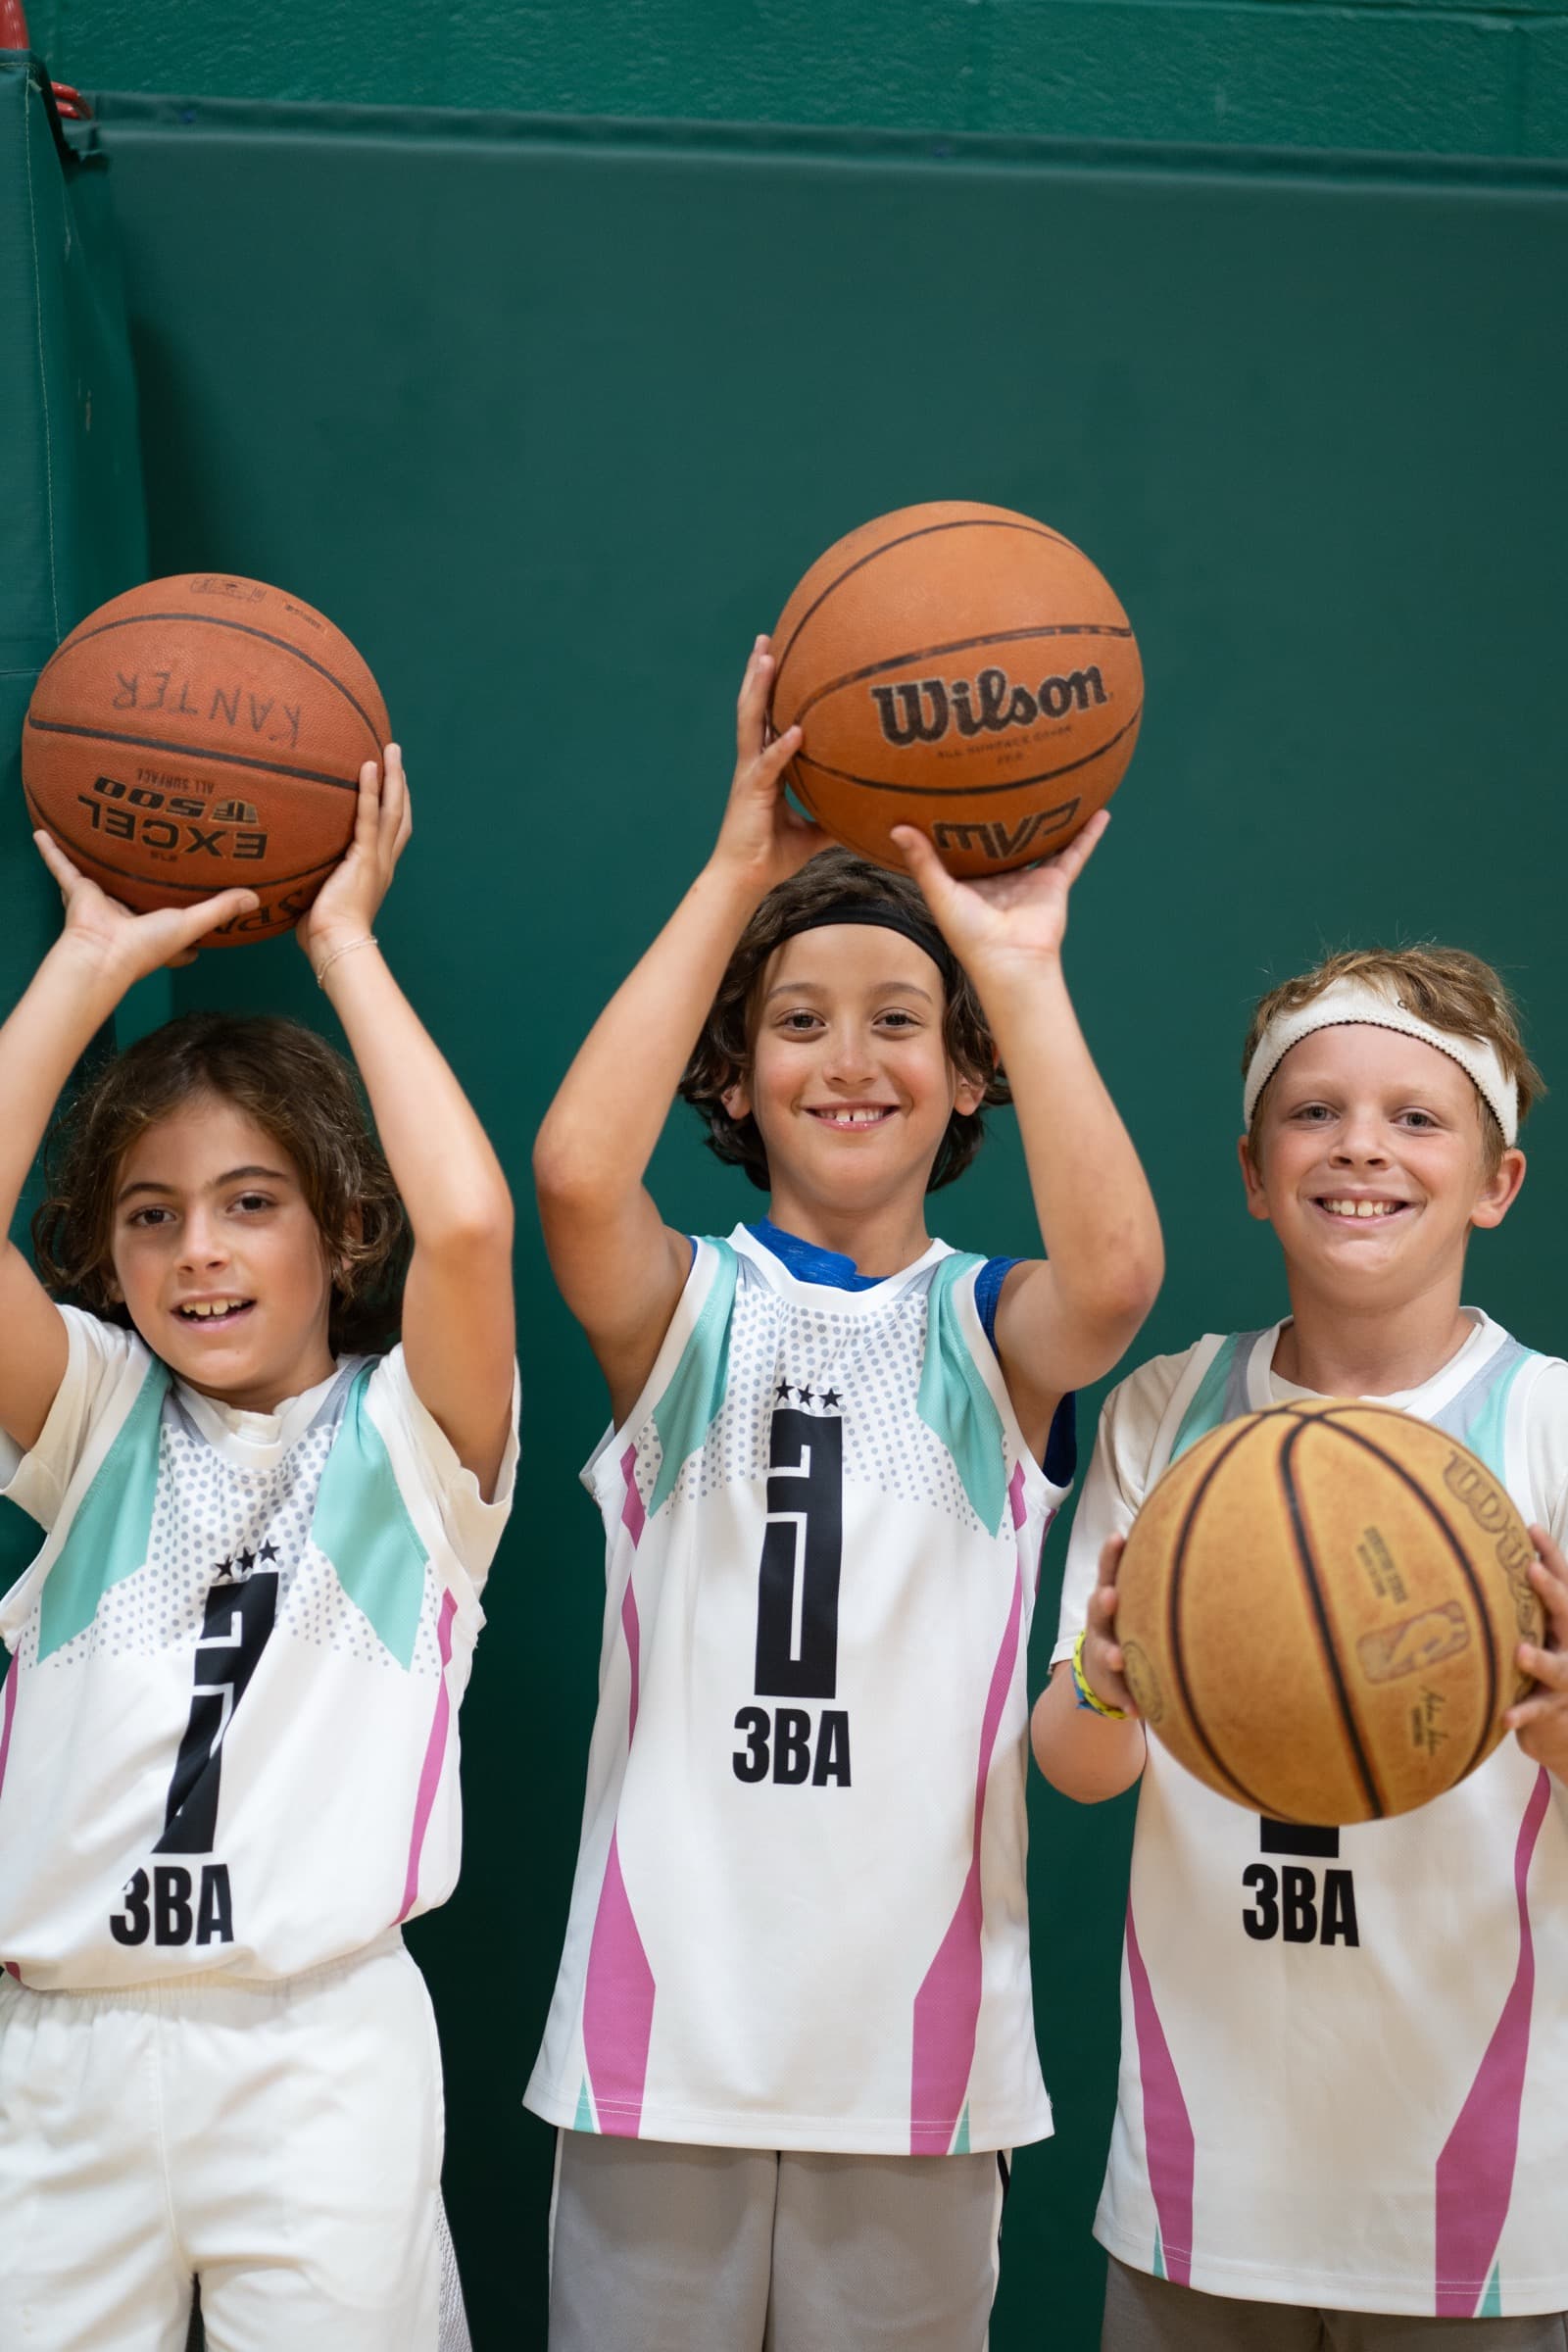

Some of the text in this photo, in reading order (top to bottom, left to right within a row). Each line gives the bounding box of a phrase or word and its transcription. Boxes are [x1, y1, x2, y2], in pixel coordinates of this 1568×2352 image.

[112, 671, 303, 747] KANTER
[871, 666, 1106, 747] Wilson
[136, 768, 215, 795] ALL SURFACE
[77, 795, 268, 860] EXCEL
[732, 1706, 852, 1788] 3BA
[109, 1863, 235, 1946] 3BA
[1241, 1862, 1360, 1947] 3BA
